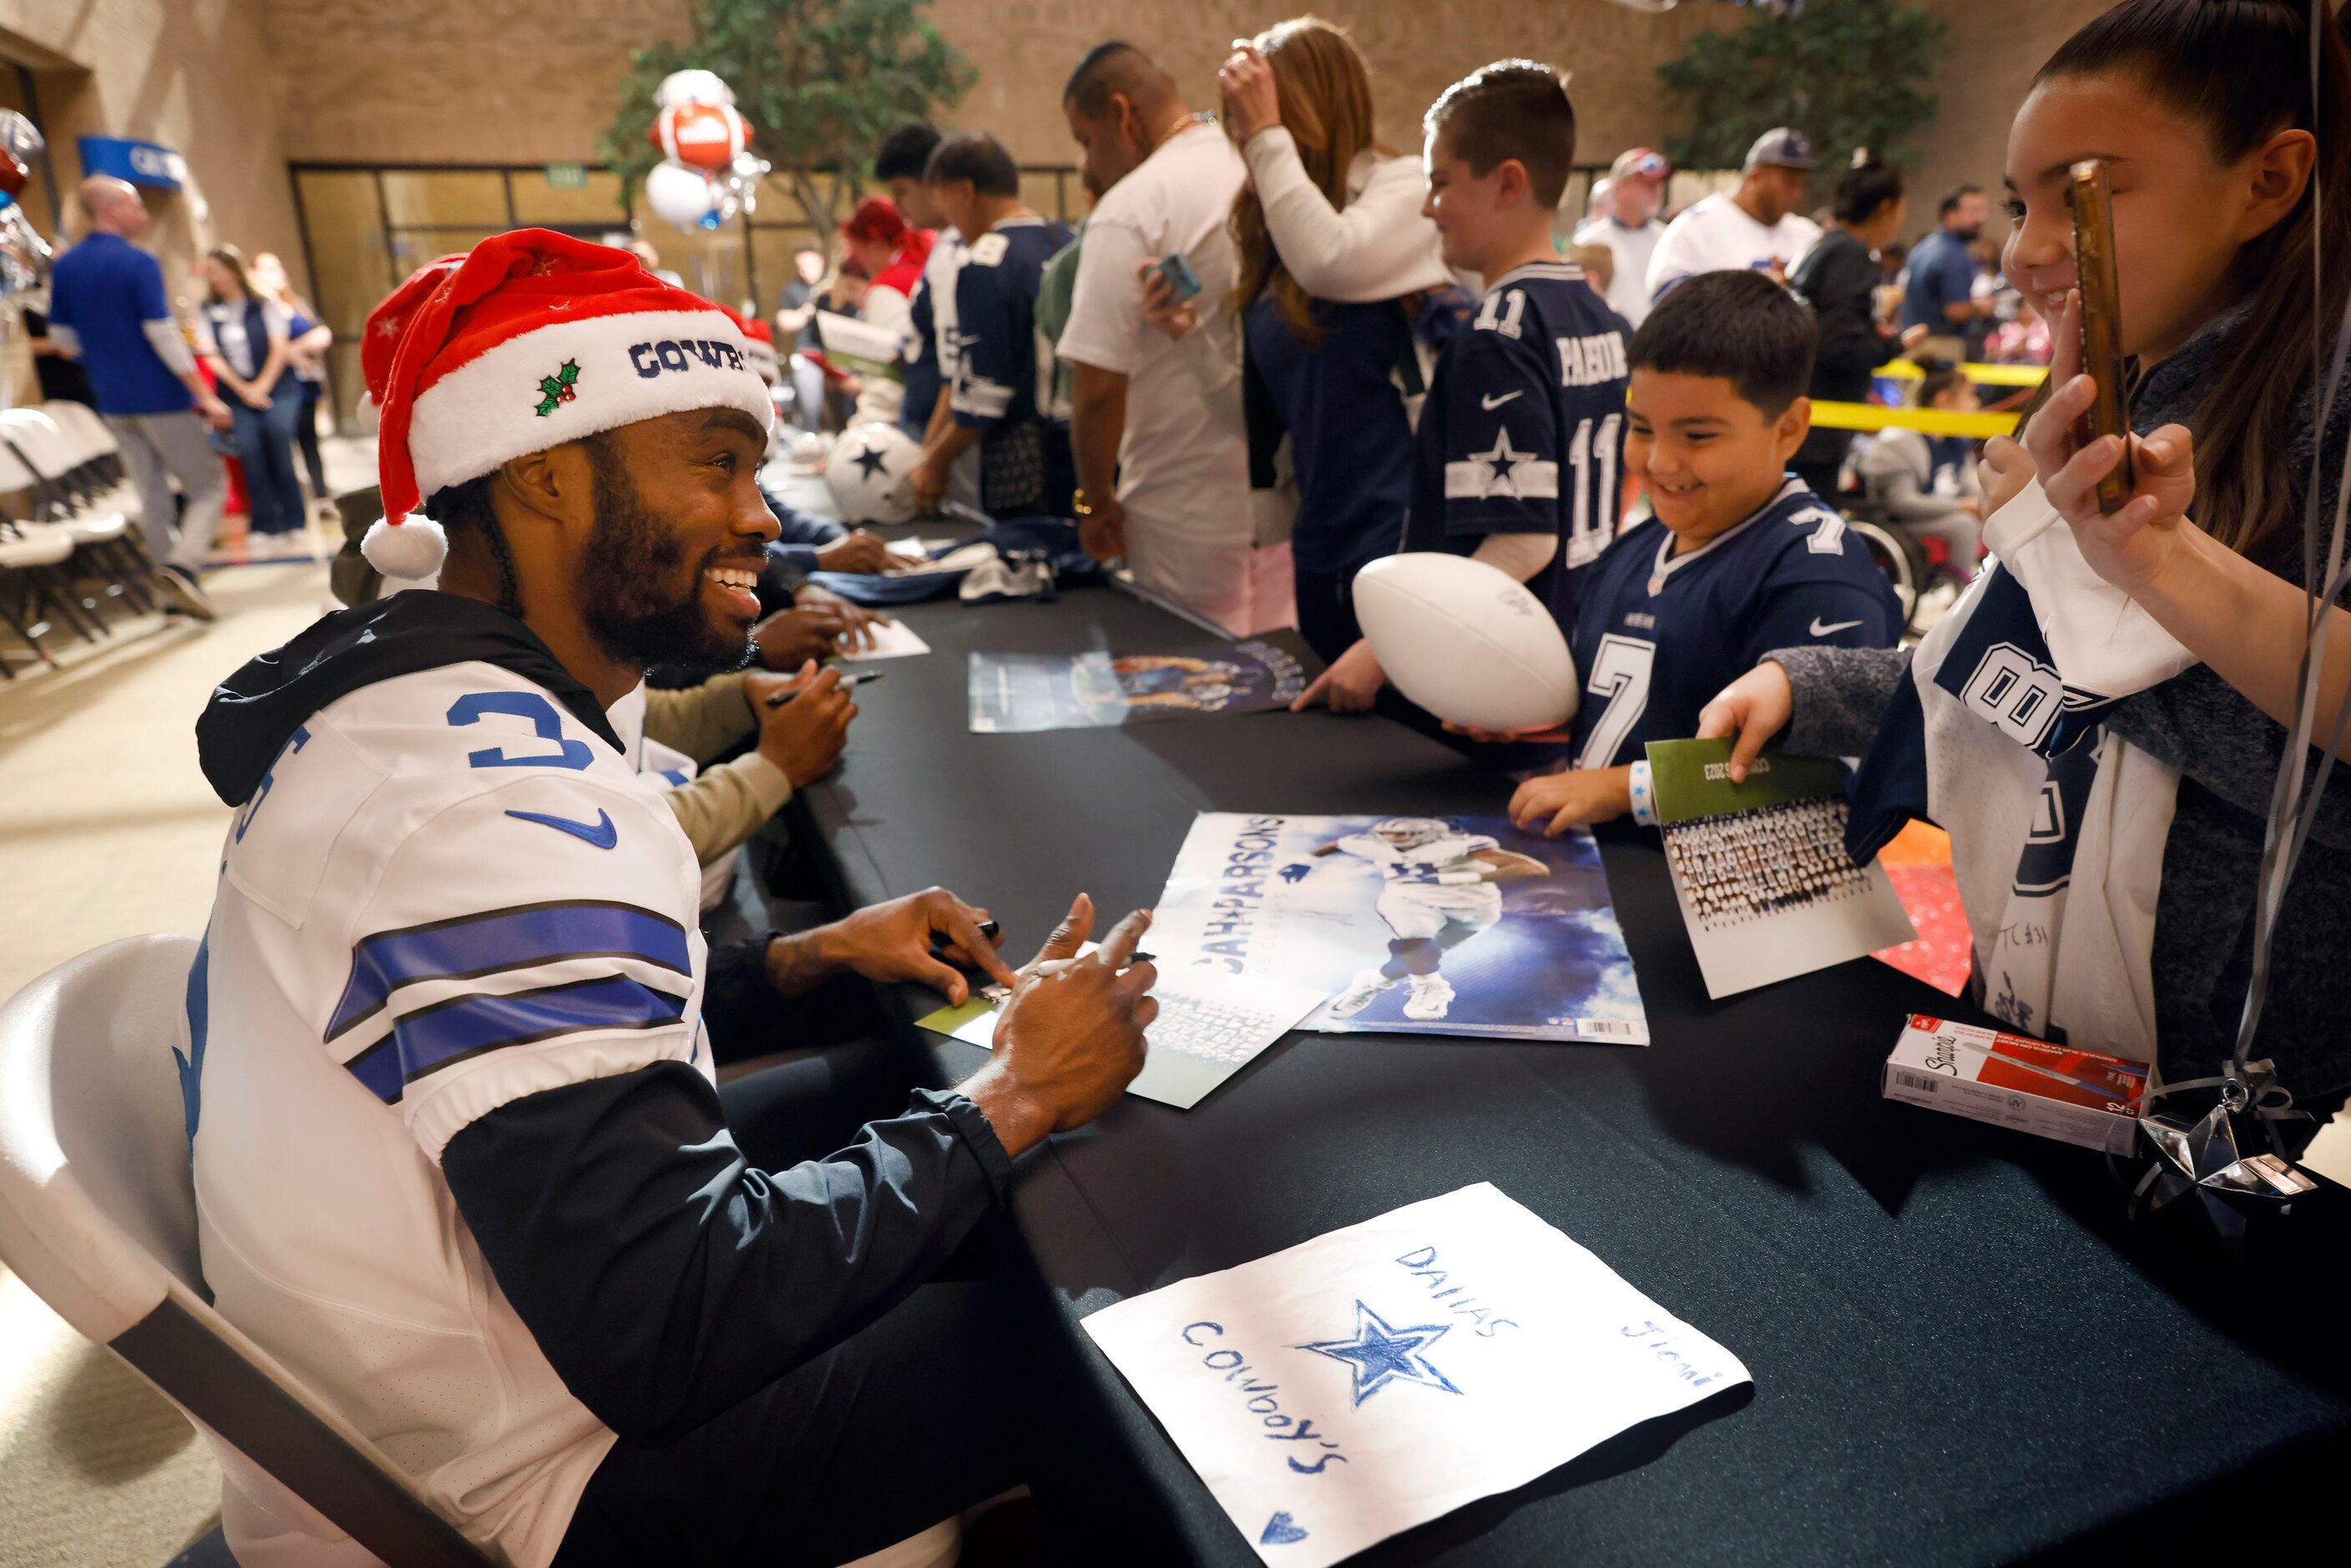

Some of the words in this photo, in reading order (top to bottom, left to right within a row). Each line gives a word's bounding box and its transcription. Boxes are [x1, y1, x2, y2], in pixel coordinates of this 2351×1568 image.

[1473, 289, 1526, 340] 11
[629, 340, 746, 378] COWB
[1566, 412, 1623, 569] 11
[1787, 506, 1846, 556] 7
[447, 691, 594, 771] 3
[1573, 633, 1656, 769] 7
